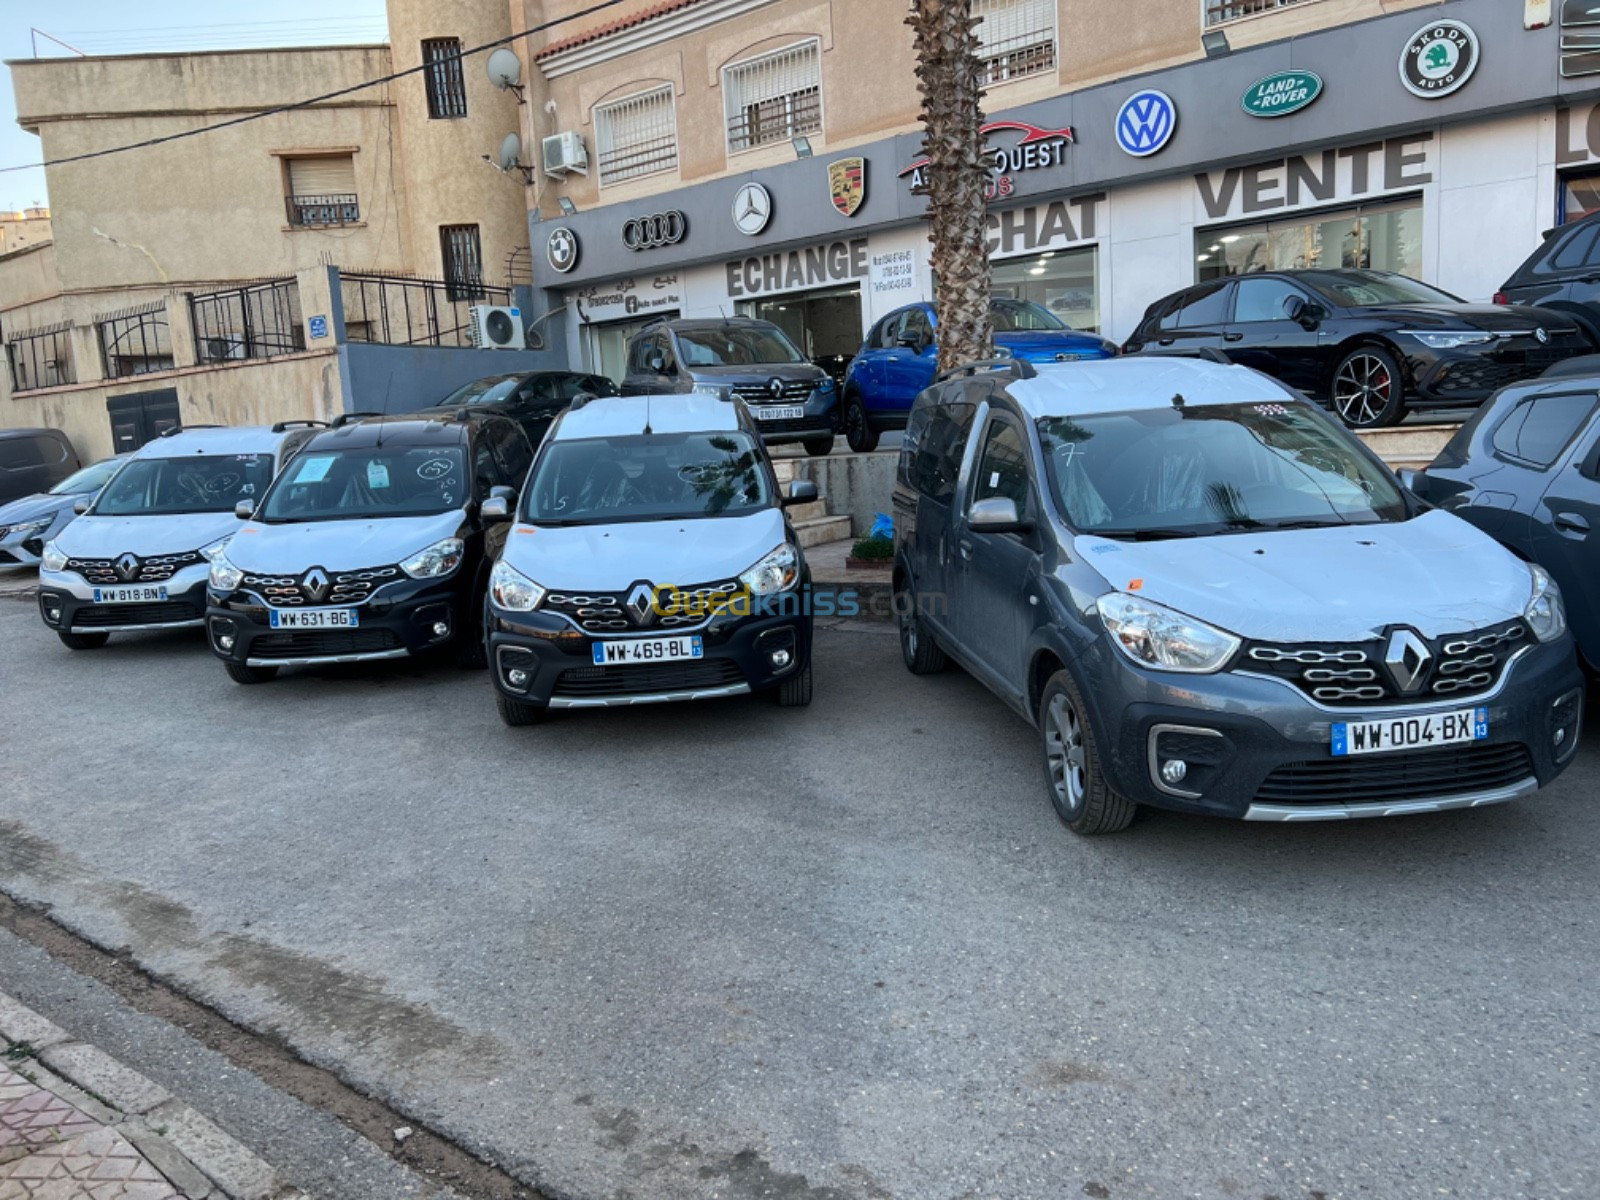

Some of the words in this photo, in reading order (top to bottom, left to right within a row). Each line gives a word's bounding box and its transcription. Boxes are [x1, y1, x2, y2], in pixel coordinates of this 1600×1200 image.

[1418, 74, 1454, 88] AUTO
[994, 140, 1065, 174] OUEST
[1194, 131, 1434, 218] VENTE
[986, 192, 1106, 253] CHAT
[726, 238, 869, 297] ECHANGE
[280, 612, 348, 626] WW-631-BG
[606, 640, 689, 661] WW-469-BL
[1353, 712, 1470, 750] WW-004-BX
[1475, 724, 1488, 736] 13
